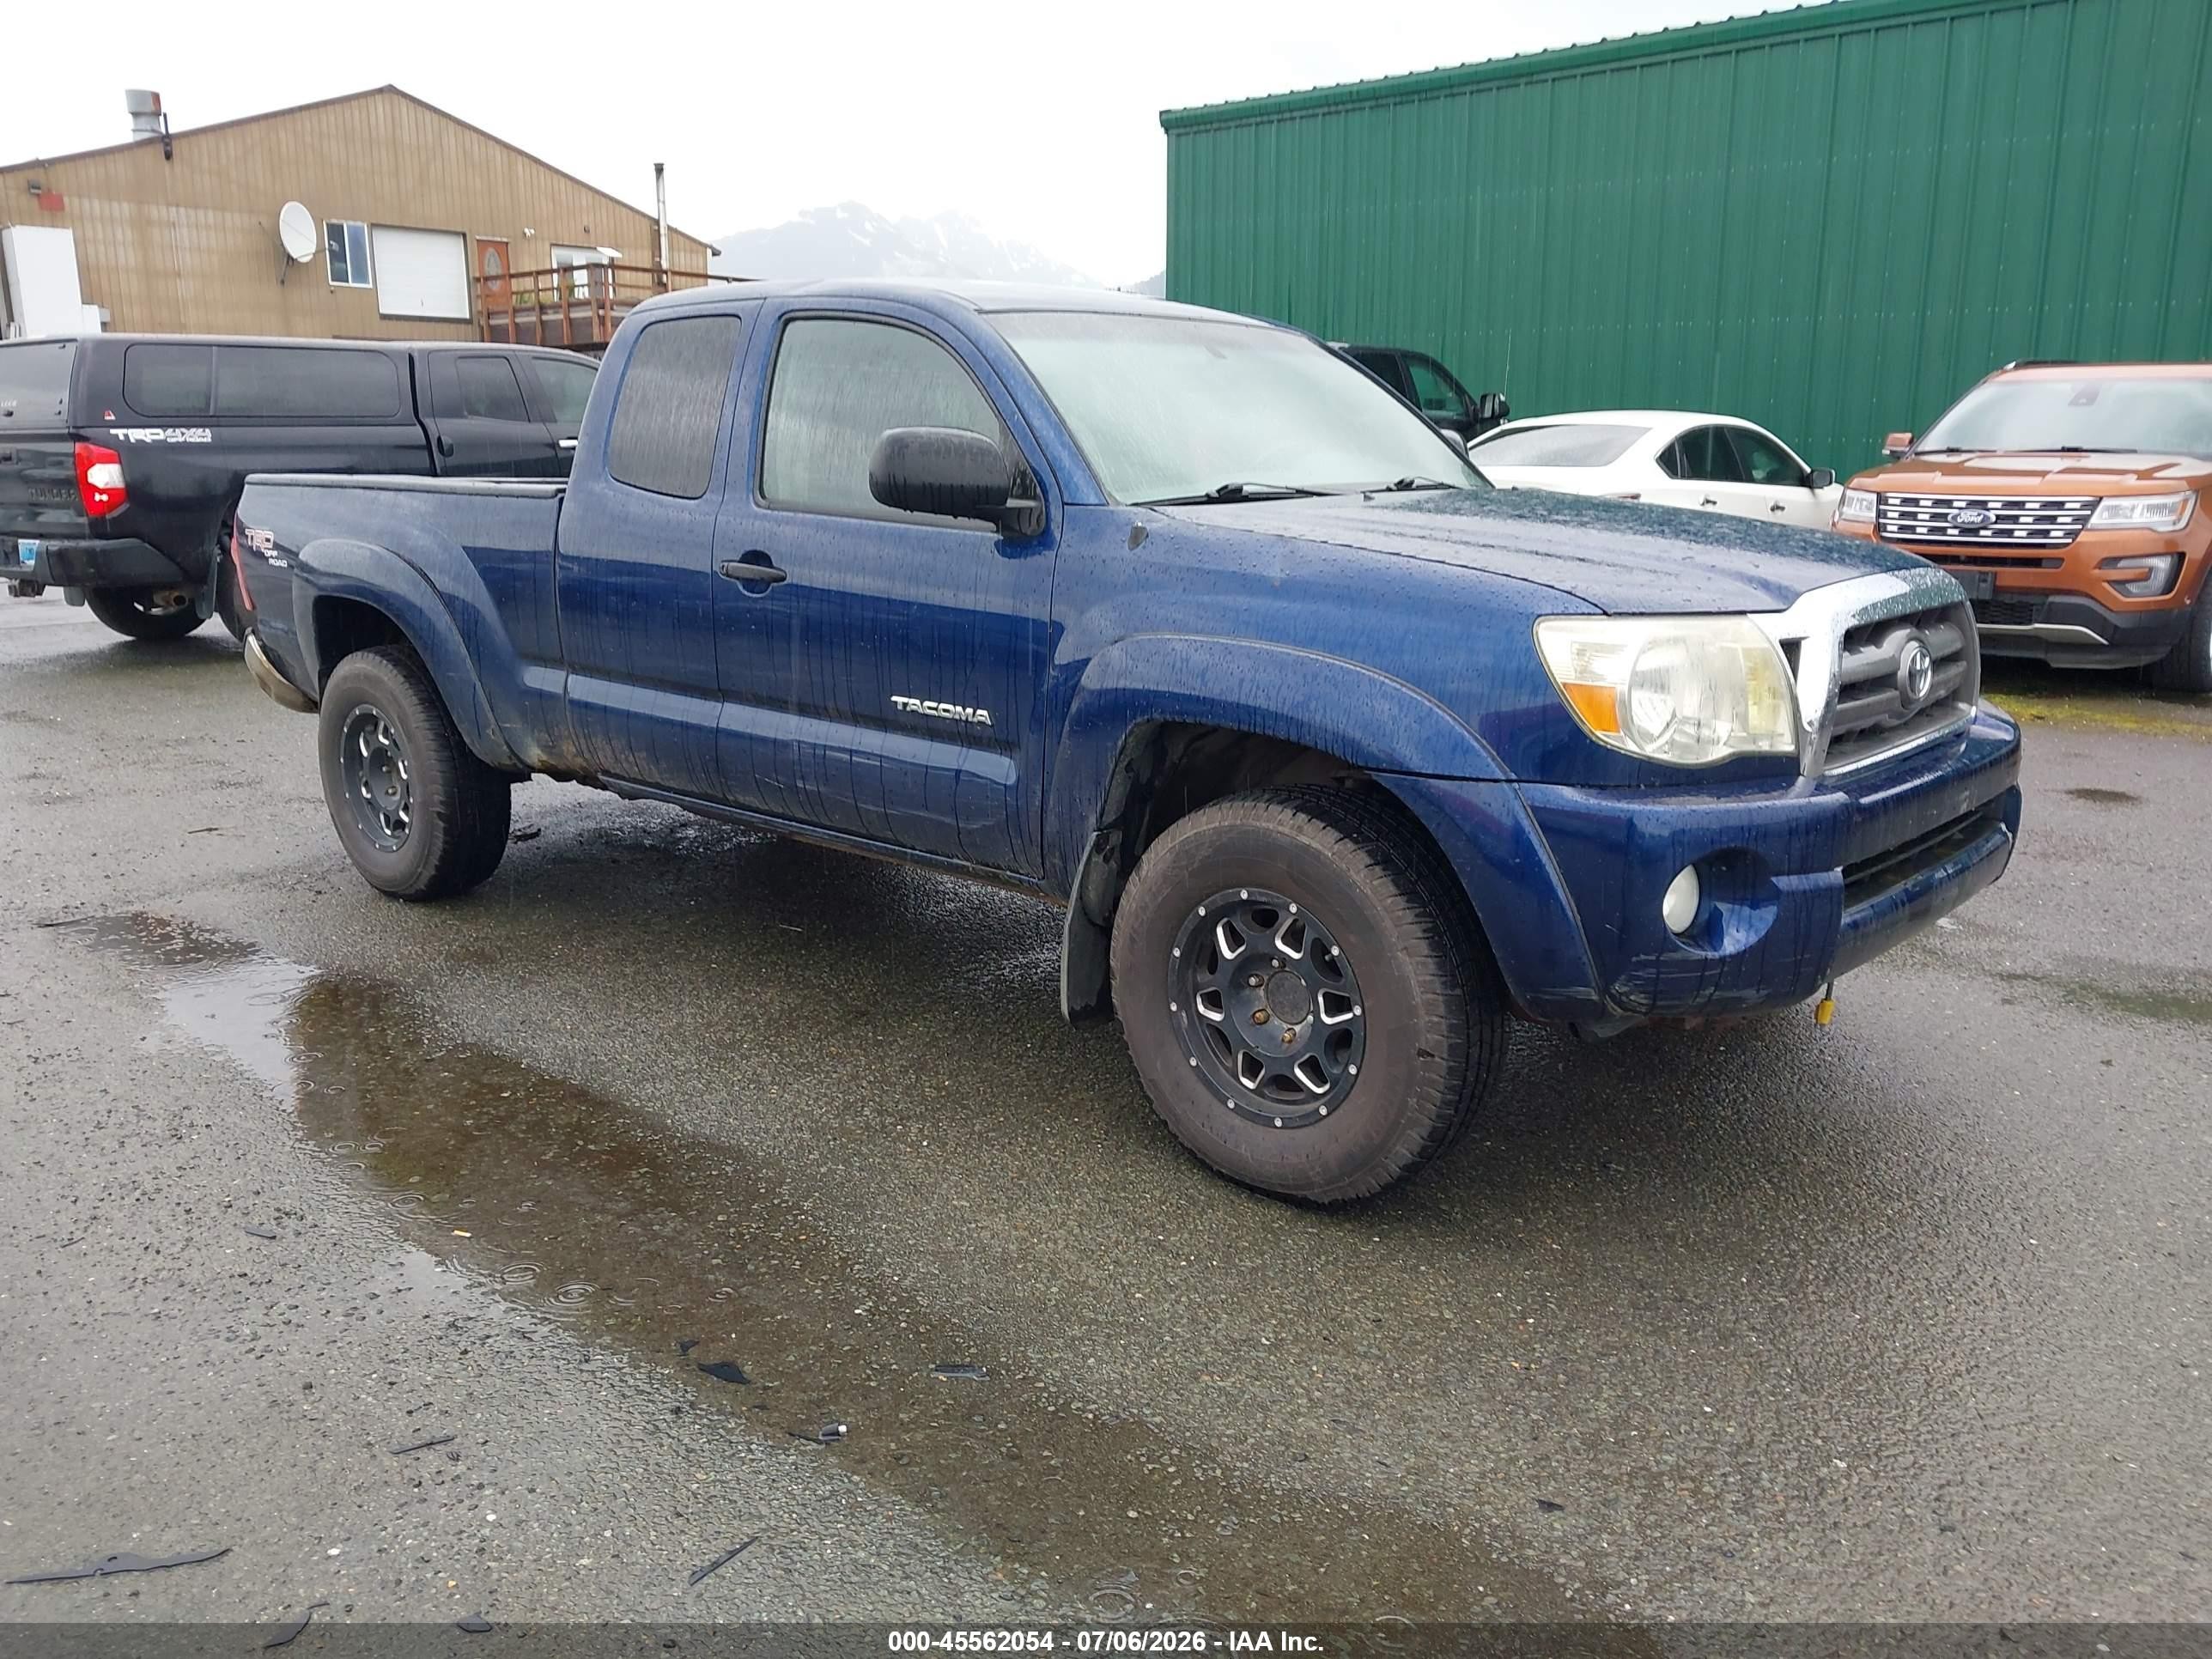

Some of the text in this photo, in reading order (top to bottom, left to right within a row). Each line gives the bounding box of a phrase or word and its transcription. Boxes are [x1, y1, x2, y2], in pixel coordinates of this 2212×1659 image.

[109, 428, 165, 443] TRD
[1957, 511, 1984, 524] Ford
[245, 528, 274, 552] TRD
[264, 550, 278, 558] OFF
[268, 558, 288, 568] ROAD
[890, 695, 992, 726] TACOMA
